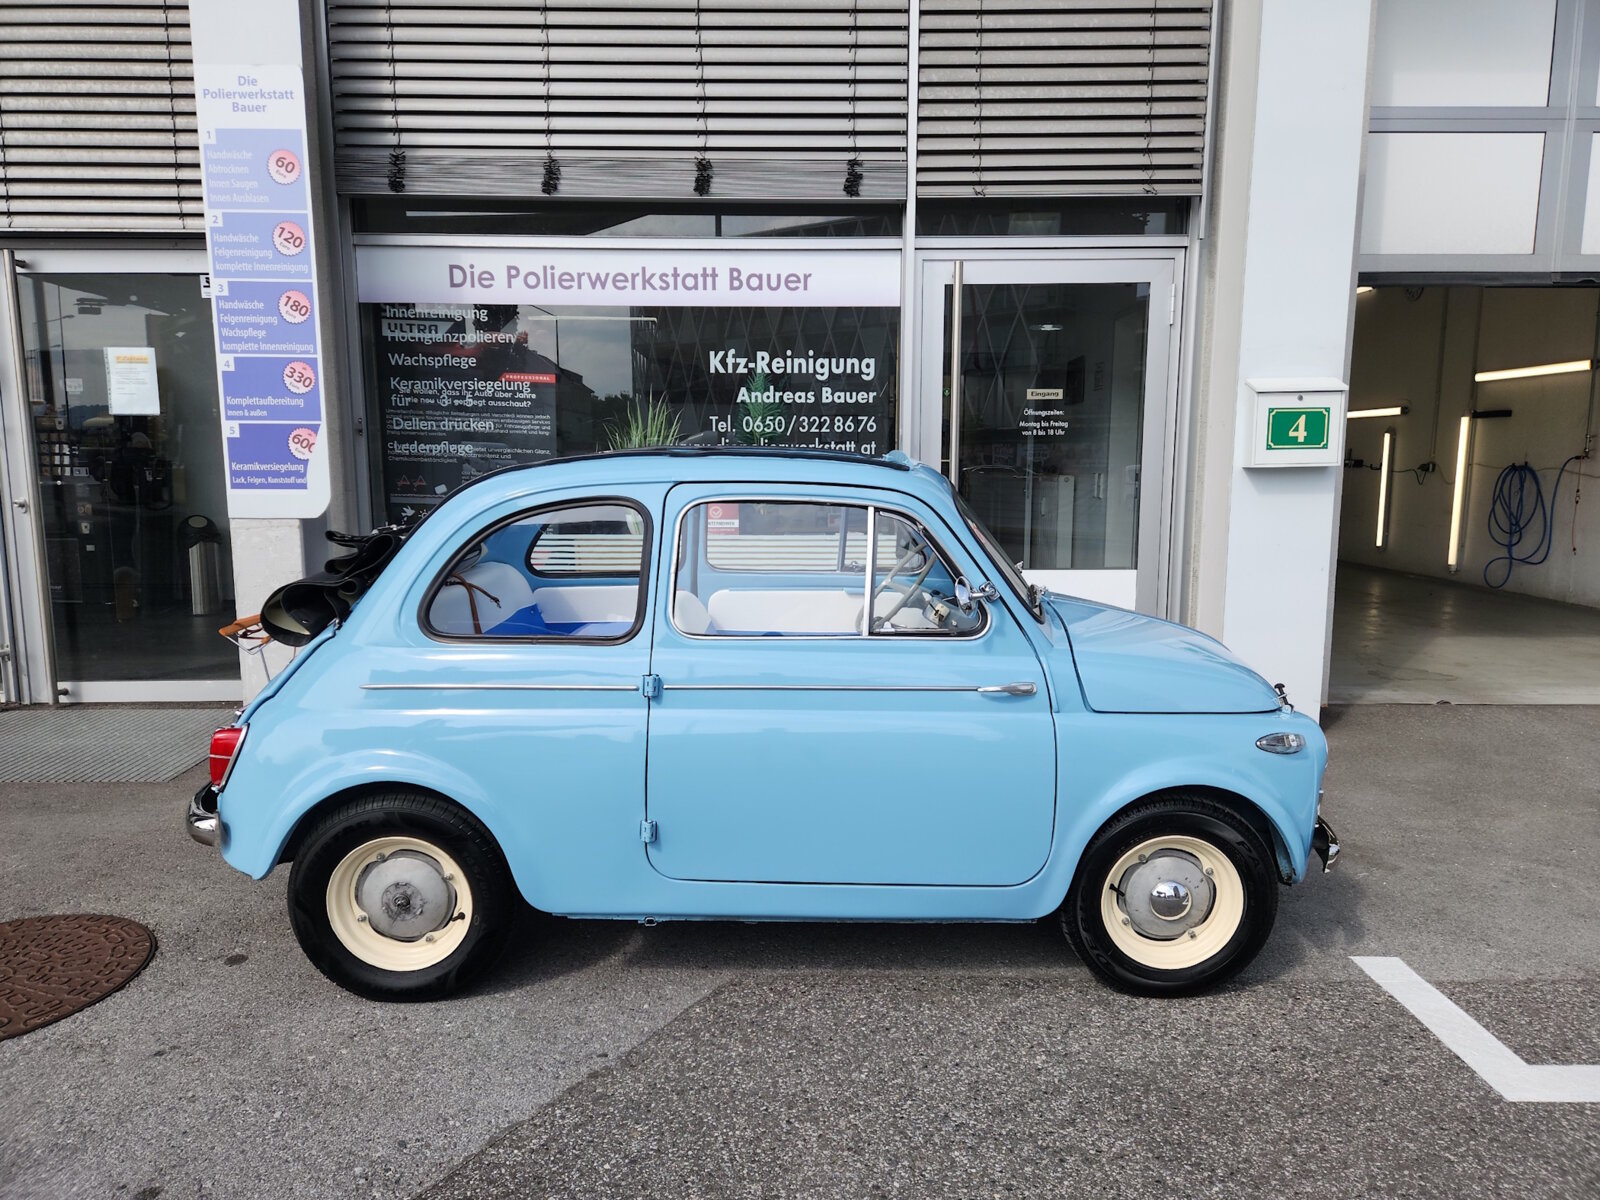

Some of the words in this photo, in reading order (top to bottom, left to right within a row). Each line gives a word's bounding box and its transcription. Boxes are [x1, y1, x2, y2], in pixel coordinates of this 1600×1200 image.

[237, 75, 258, 86] Die
[202, 88, 294, 100] Polierwerkstatt
[232, 102, 267, 112] Bauer
[206, 130, 211, 139] 1
[275, 156, 295, 173] 60
[212, 215, 218, 224] 2
[213, 233, 259, 243] Handwäsche
[278, 227, 303, 248] 120
[214, 247, 273, 259] Felgenreinigung
[215, 261, 252, 272] komplette
[253, 262, 308, 273] Innenreinigung
[448, 263, 495, 289] Die
[506, 265, 719, 292] Polierwerkstatt
[728, 267, 812, 292] Bauer
[218, 284, 224, 293] 3
[218, 300, 264, 309] Handwäsche
[284, 296, 309, 317] 180
[220, 314, 277, 325] Felgenreinigung
[385, 305, 489, 322] Innenreinigung
[221, 328, 267, 338] Wachspflege
[387, 322, 439, 334] ULTRA
[387, 330, 515, 345] Hochglanzpolieren
[222, 341, 259, 353] komplette
[260, 342, 314, 353] Innenreinigung
[224, 360, 230, 368] 4
[388, 352, 477, 369] Wachspflege
[709, 348, 876, 381] Kfz-Reinigung
[285, 366, 313, 388] 330
[390, 376, 531, 393] Keramikversiegelung
[391, 394, 411, 406] für
[736, 385, 816, 404] Andreas
[821, 387, 877, 404] Bauer
[226, 396, 304, 407] Komplettaufbereitung
[487, 400, 532, 408] ausschaut?
[250, 409, 268, 417] außen
[1023, 407, 1065, 417] Öffnungszeiten:
[393, 417, 436, 430] Dellen
[440, 417, 495, 432] drücken
[709, 415, 736, 433] Tel.
[1019, 421, 1041, 429] Montag
[1050, 421, 1069, 429] Freitag
[1288, 414, 1308, 443] 4
[229, 426, 235, 435] 5
[393, 440, 473, 456] Lederpflege
[231, 462, 304, 472] Keramikversiegelung
